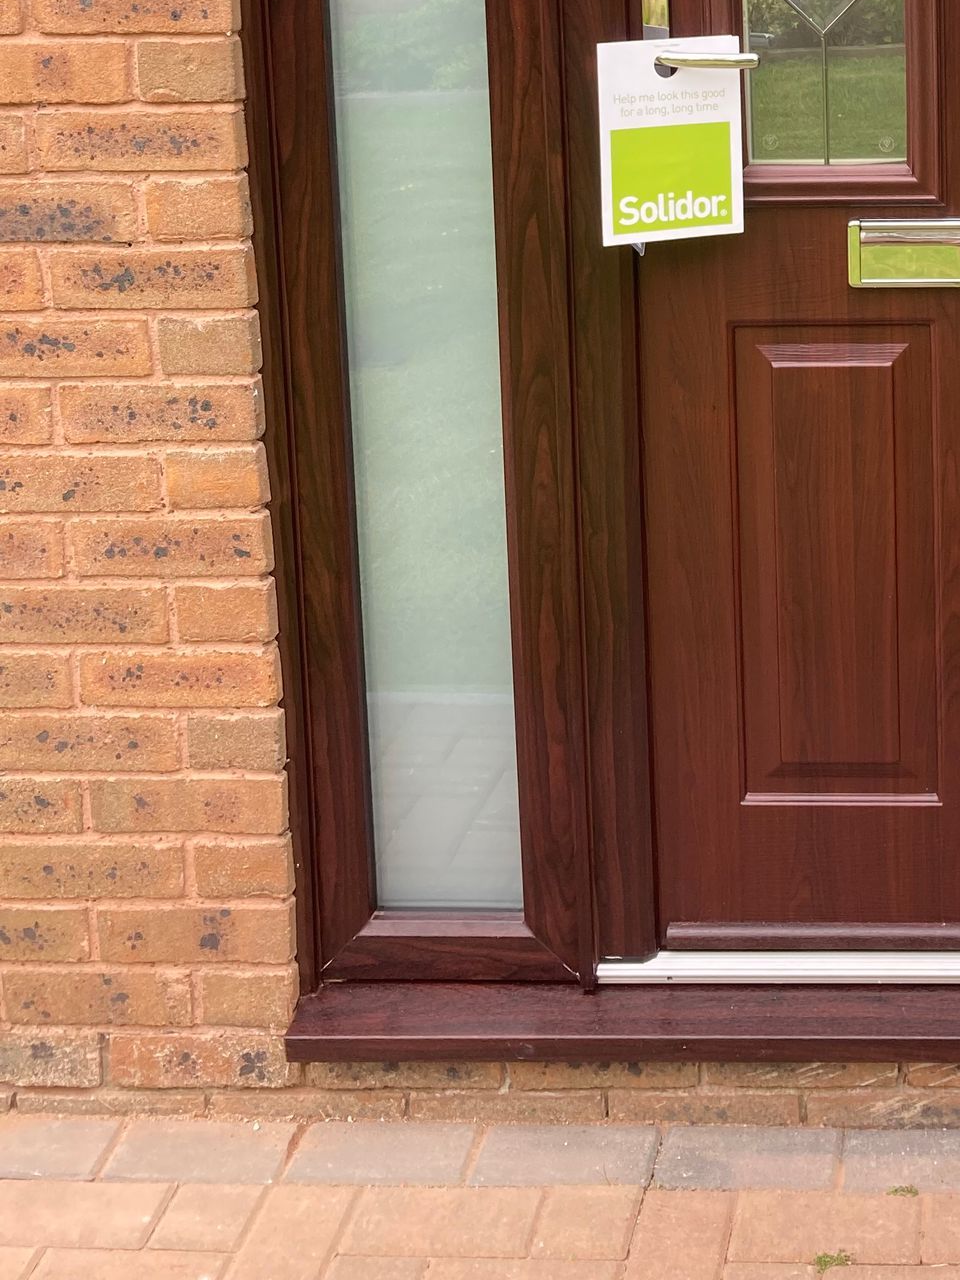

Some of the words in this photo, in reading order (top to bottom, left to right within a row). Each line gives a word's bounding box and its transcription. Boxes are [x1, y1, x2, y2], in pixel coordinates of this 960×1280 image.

[613, 93, 637, 105] Help
[639, 93, 655, 103] me
[657, 91, 680, 102] look
[680, 90, 700, 100] this
[702, 88, 726, 101] good
[620, 107, 634, 118] for
[636, 108, 643, 116] a
[645, 105, 670, 117] long,
[672, 103, 694, 115] long
[696, 101, 719, 112] time
